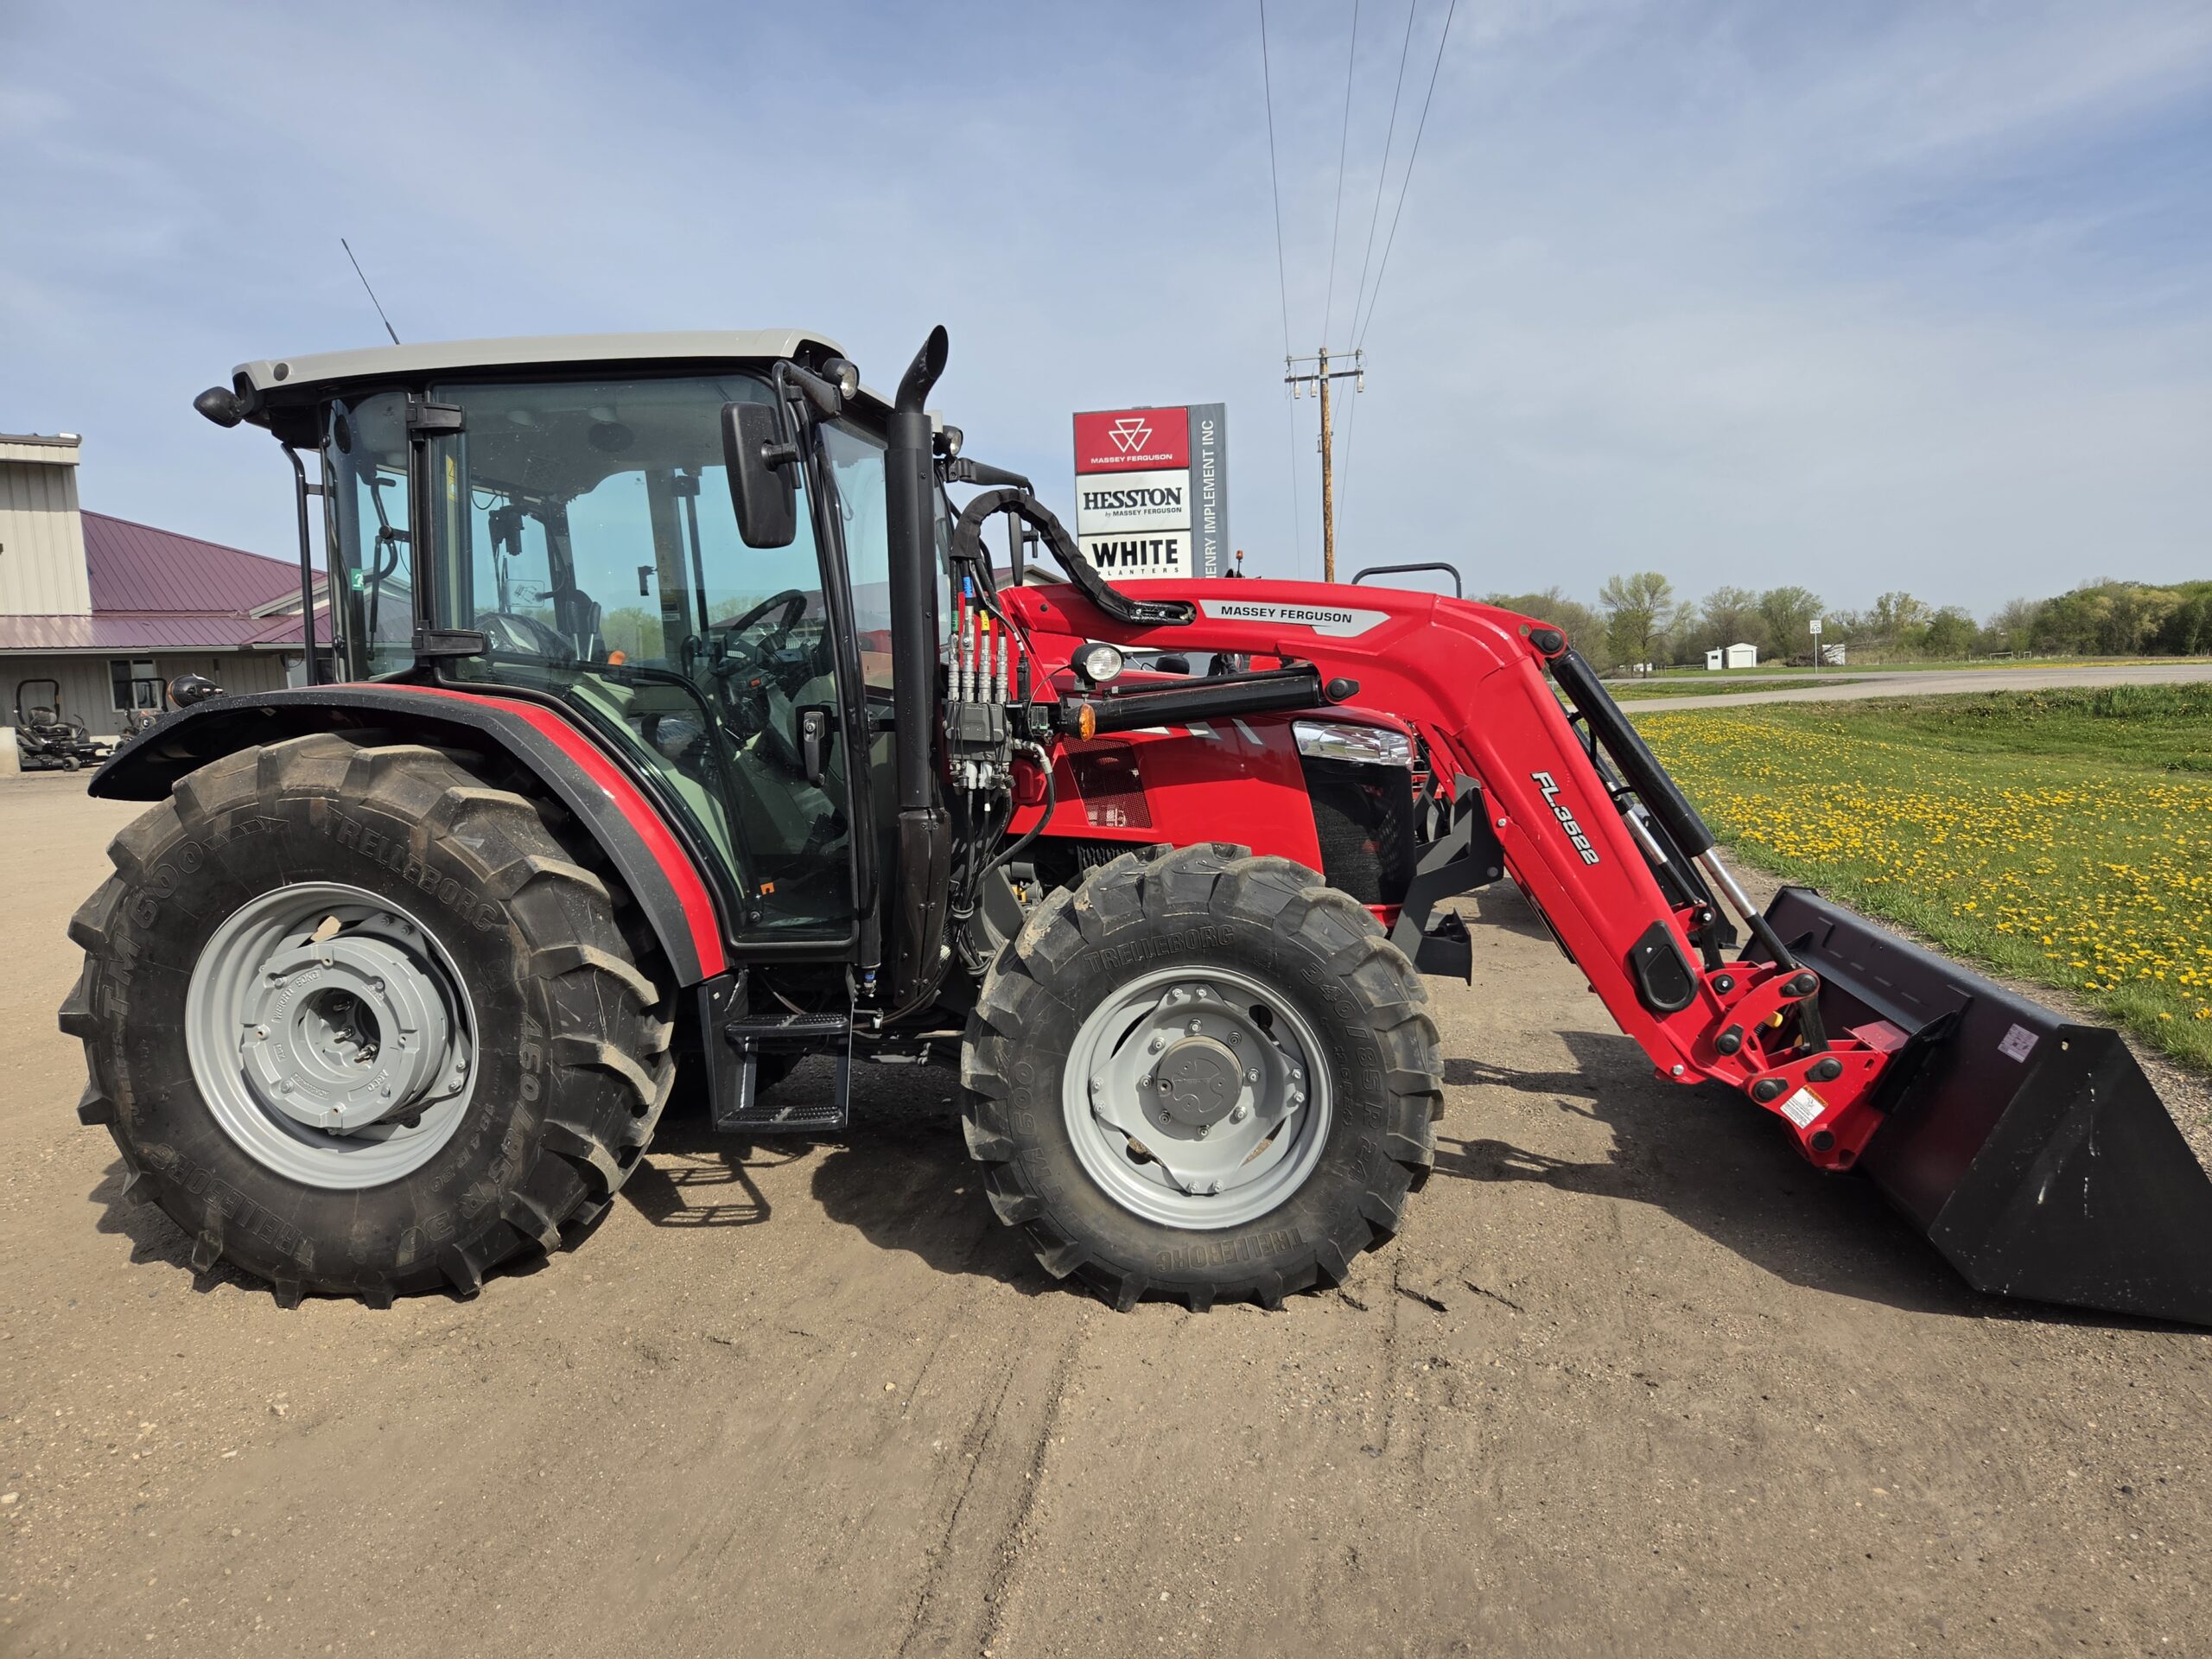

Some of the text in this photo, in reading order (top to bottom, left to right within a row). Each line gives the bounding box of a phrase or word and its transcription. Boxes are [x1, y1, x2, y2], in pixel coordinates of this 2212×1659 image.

[1127, 454, 1173, 462] FERGUSON
[1084, 487, 1182, 511] HESSTON
[1143, 506, 1182, 515] FERGUSON
[1201, 420, 1217, 578] ENRY IMPLEMENT INC
[1092, 538, 1179, 568] WHITE
[1221, 606, 1352, 623] MASSEY FERGUSON
[1529, 771, 1601, 866] FL.3522
[323, 804, 498, 932] TRELLEBORG
[102, 840, 205, 1016] TM 600
[1084, 924, 1235, 973] TRELLEBORG
[270, 988, 295, 1024] WEIGHT
[1300, 962, 1382, 1091] 340/85
[366, 1069, 388, 1092] AGCO
[149, 1142, 315, 1270] TRELLEBORG
[1156, 1227, 1309, 1272] TRELLEBORG
